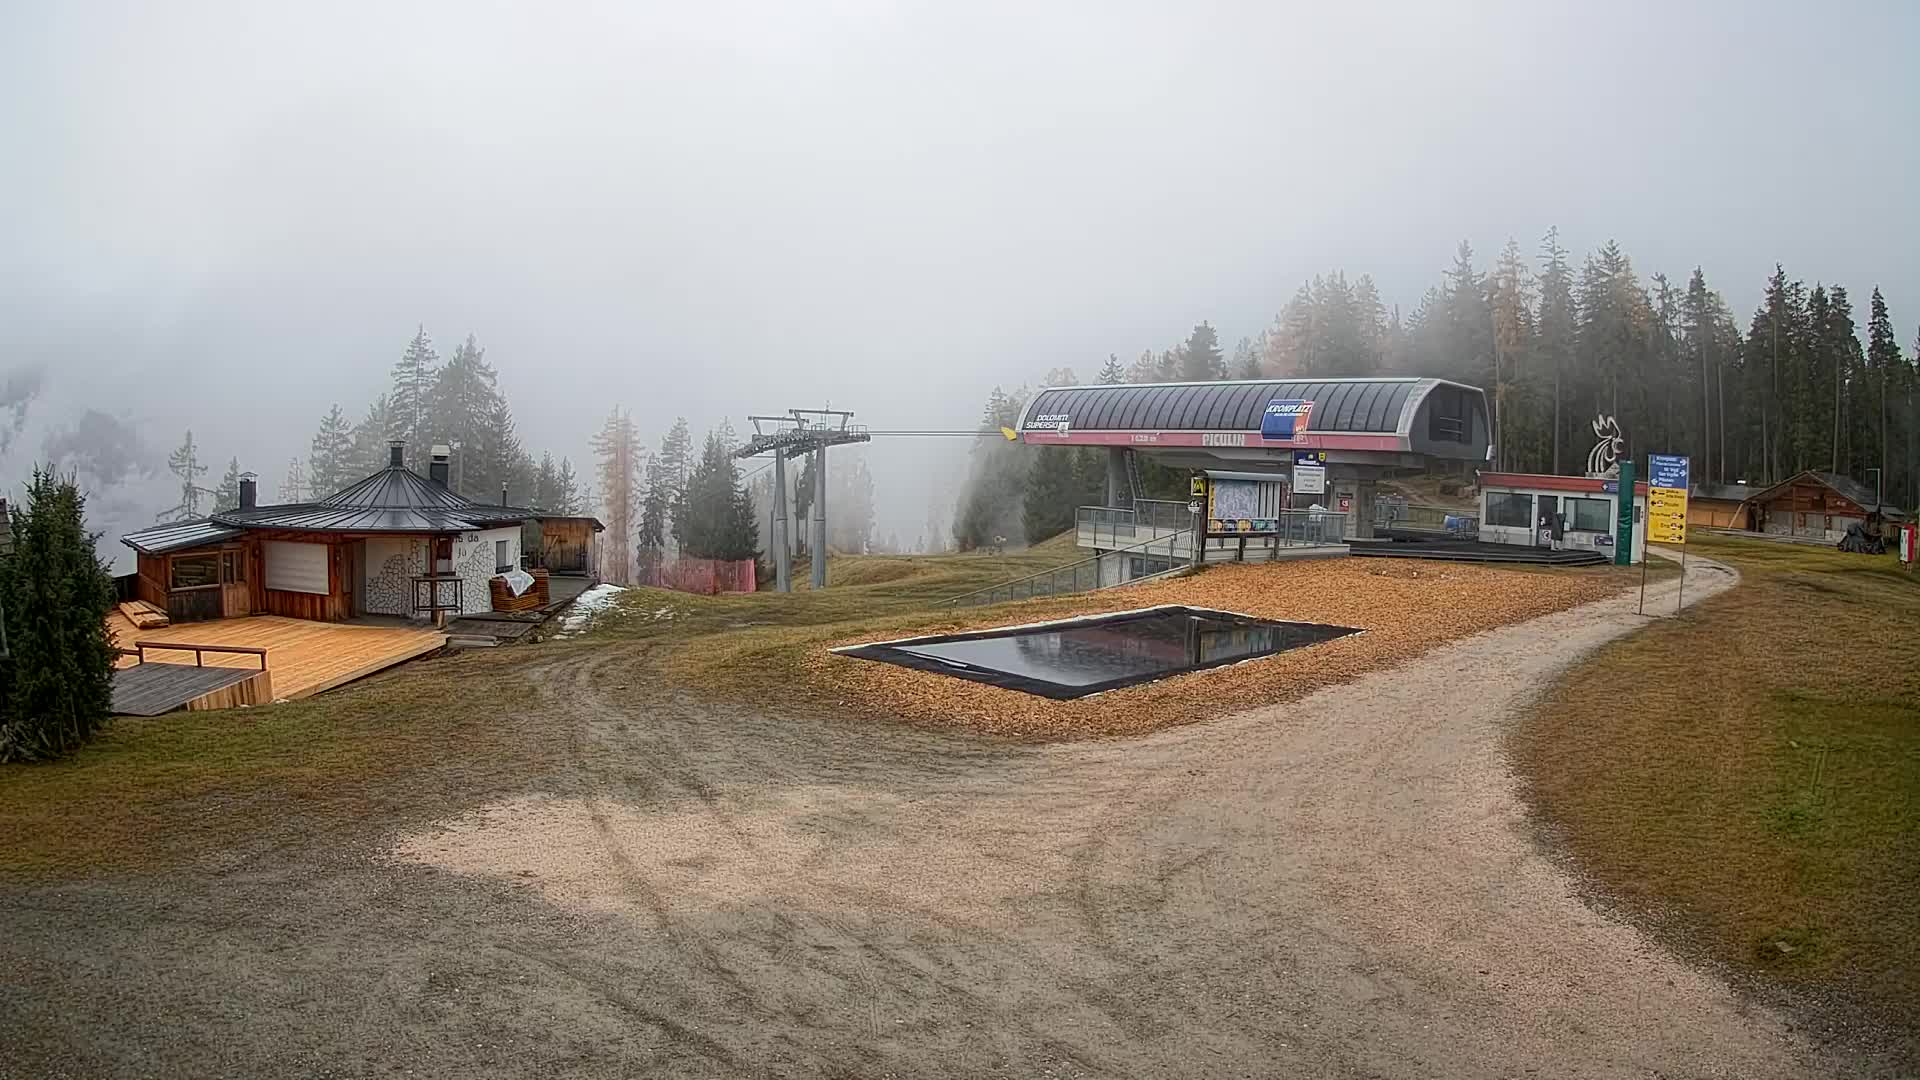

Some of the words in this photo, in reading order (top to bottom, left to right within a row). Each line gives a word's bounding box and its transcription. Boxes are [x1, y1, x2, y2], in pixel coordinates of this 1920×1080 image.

[1026, 421, 1059, 429] SUPERSKI
[1202, 433, 1245, 447] PICULIN
[467, 533, 479, 543] da
